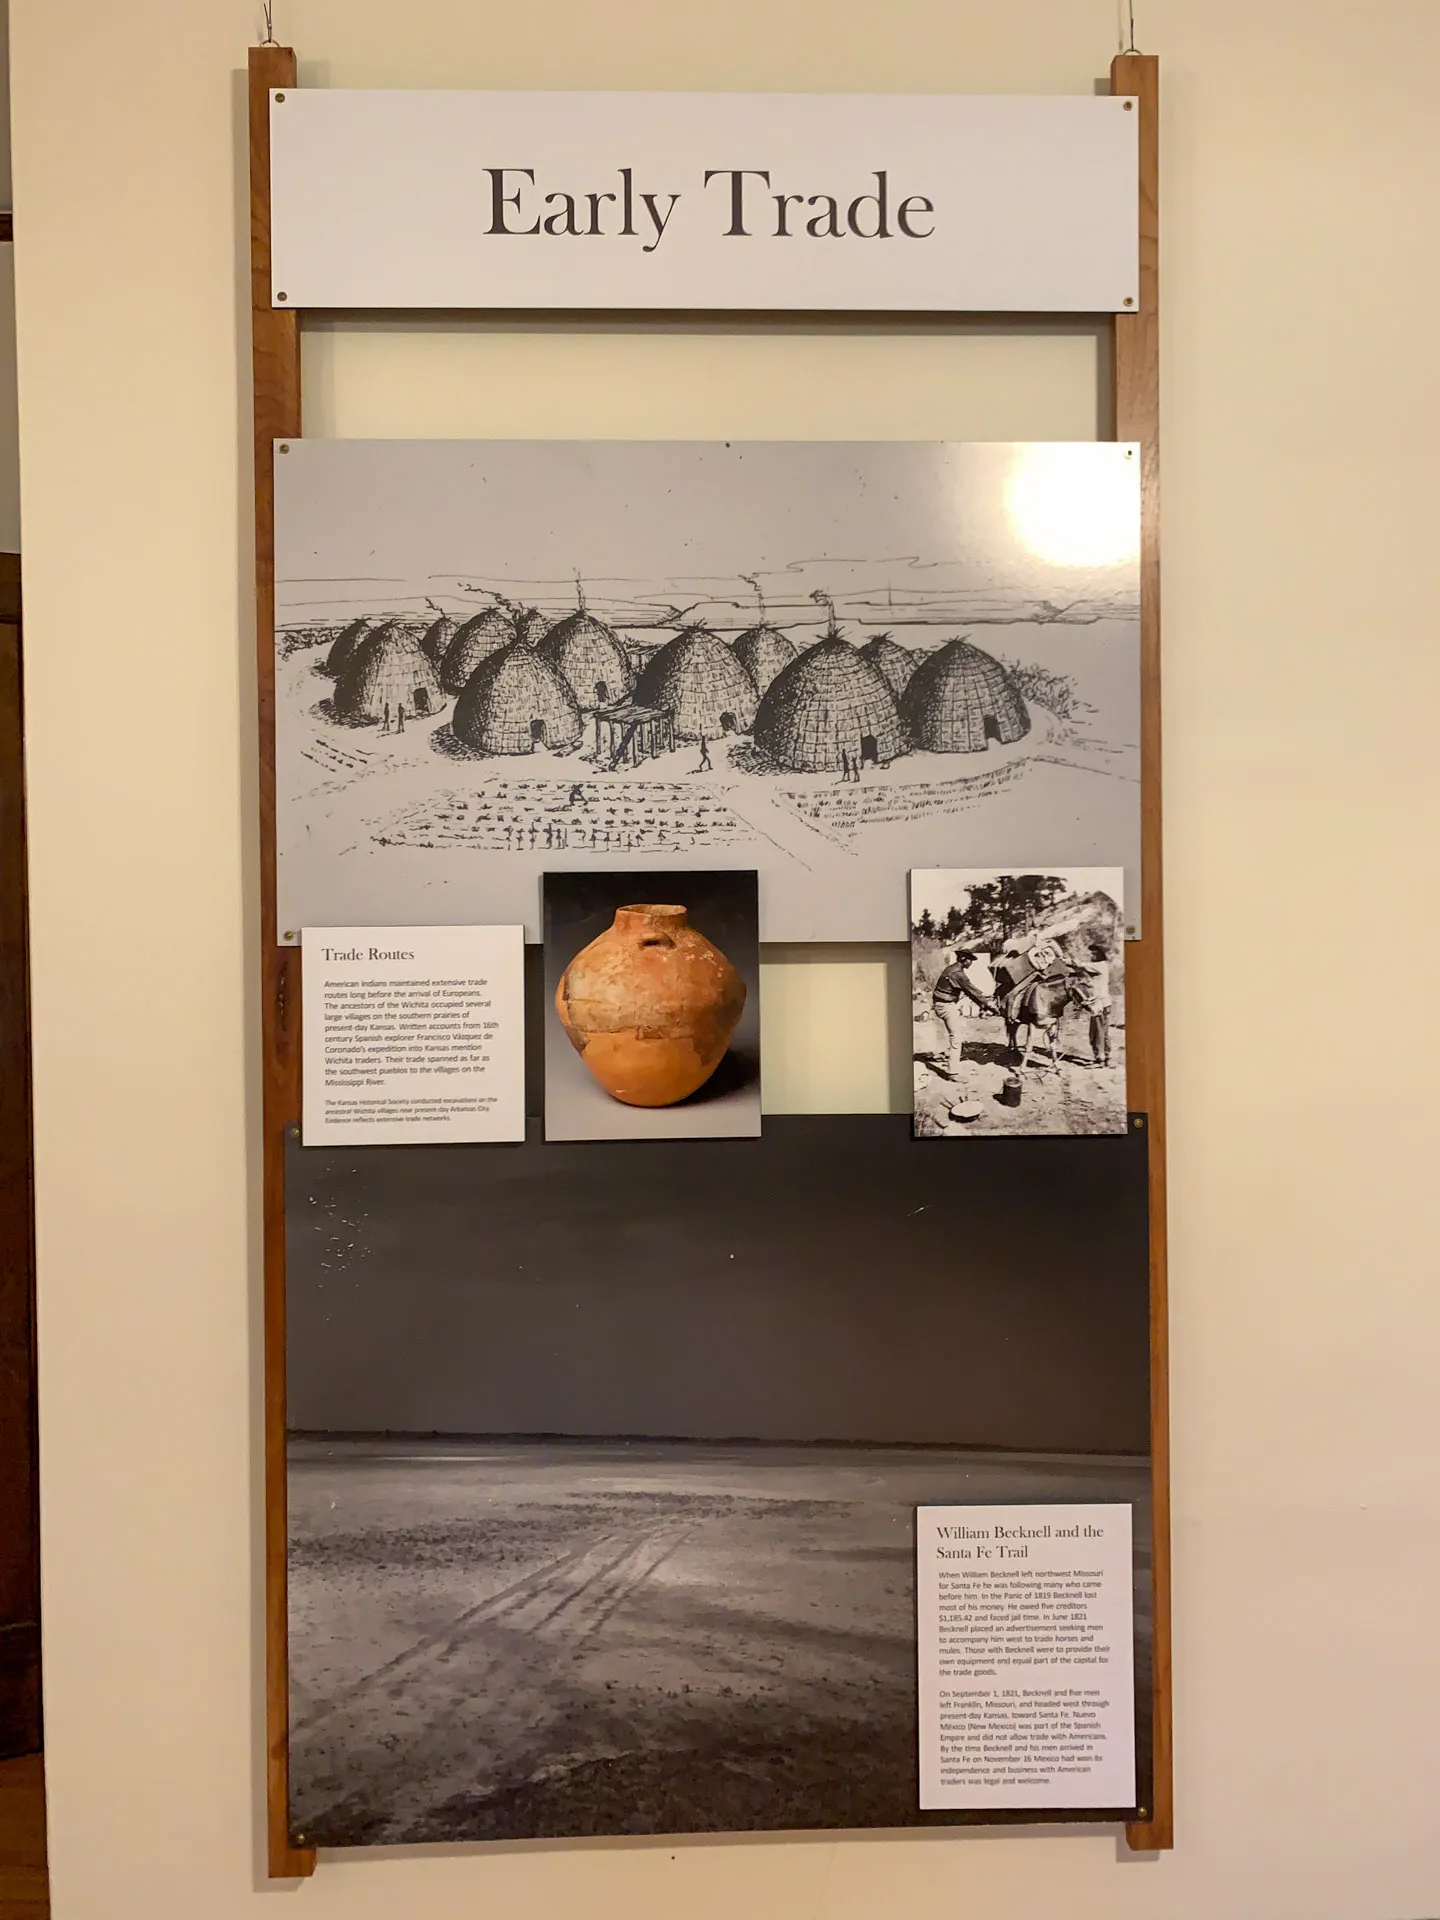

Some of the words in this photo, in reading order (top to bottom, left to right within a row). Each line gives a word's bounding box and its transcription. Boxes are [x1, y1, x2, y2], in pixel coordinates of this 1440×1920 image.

[482, 168, 681, 253] Early
[704, 170, 936, 239] Trade
[322, 948, 363, 961] Trade
[368, 947, 415, 960] Routes
[324, 979, 359, 988] American
[361, 979, 387, 988] Indians
[388, 978, 430, 987] maintained
[431, 978, 465, 987] extensive
[467, 978, 487, 986] trade
[325, 990, 348, 999] routes
[349, 990, 366, 1000] long
[367, 990, 391, 998] before
[393, 989, 406, 998] the
[407, 989, 431, 998] arrival
[432, 989, 440, 998] of
[441, 989, 481, 1000] Europeans.
[325, 1001, 338, 1010] The
[340, 1001, 375, 1010] ancestors
[377, 1001, 385, 1009] of
[386, 1000, 399, 1009] the
[401, 1000, 429, 1009] Wichita
[430, 1000, 463, 1010] occupied
[465, 999, 491, 1008] several
[325, 1012, 343, 1023] large
[344, 1012, 371, 1023] villages
[384, 1011, 396, 1020] the
[398, 1011, 431, 1020] southern
[433, 1011, 460, 1021] prairies
[461, 1010, 469, 1019] of
[398, 1021, 426, 1030] Written
[428, 1021, 460, 1030] accounts
[462, 1021, 480, 1030] from
[483, 1021, 499, 1029] 16th
[325, 1034, 353, 1045] century
[354, 1033, 382, 1044] Spanish
[384, 1033, 414, 1044] explorer
[416, 1032, 450, 1041] Francisco
[483, 1032, 493, 1040] de
[367, 1044, 406, 1055] expedition
[408, 1044, 422, 1052] into
[424, 1043, 449, 1052] Kansas
[450, 1043, 482, 1052] mention
[325, 1056, 353, 1064] Wichita
[355, 1055, 382, 1064] traders.
[385, 1055, 404, 1064] Their
[405, 1054, 425, 1063] trade
[427, 1054, 458, 1065] spanned
[469, 1054, 479, 1062] far
[325, 1067, 337, 1076] the
[339, 1066, 377, 1075] southwest
[378, 1066, 407, 1077] pueblos
[409, 1066, 417, 1074] to
[419, 1065, 432, 1074] the
[433, 1065, 459, 1076] villages
[472, 1064, 485, 1073] the
[326, 1077, 364, 1088] Mississippi
[365, 1077, 385, 1086] River.
[936, 1526, 990, 1539] William
[993, 1525, 1050, 1539] Becknell
[1055, 1525, 1079, 1538] and
[1082, 1525, 1103, 1538] the
[936, 1545, 972, 1559] Santa
[976, 1545, 991, 1558] Fe
[995, 1545, 1028, 1558] Trail
[939, 1570, 960, 1579] When
[961, 1570, 988, 1579] William
[990, 1570, 1019, 1578] Becknell
[1020, 1569, 1033, 1578] left
[1034, 1569, 1071, 1578] northwest
[1072, 1569, 1103, 1578] Missouri
[939, 1581, 949, 1590] for
[950, 1581, 970, 1590] Santa
[972, 1581, 981, 1590] Fe
[982, 1581, 992, 1590] he
[1009, 1580, 1041, 1591] following
[1043, 1583, 1063, 1591] many
[1065, 1580, 1080, 1589] who
[939, 1592, 962, 1601] before
[981, 1591, 988, 1600] In
[989, 1591, 1002, 1600] the
[1003, 1591, 1022, 1600] Panic
[1024, 1591, 1031, 1600] of
[1034, 1591, 1051, 1599] 1819
[1052, 1590, 1082, 1599] Becknell
[939, 1603, 956, 1611] most
[958, 1602, 966, 1611] of
[967, 1602, 978, 1611] his
[1007, 1602, 1017, 1611] He
[1019, 1602, 1039, 1610] owed
[1041, 1602, 1054, 1610] five
[1055, 1601, 1087, 1610] creditors
[974, 1613, 988, 1622] and
[989, 1613, 1009, 1622] faced
[1010, 1613, 1021, 1623] jail
[1022, 1613, 1040, 1621] time.
[1042, 1613, 1050, 1621] In
[1052, 1613, 1067, 1621] June
[1070, 1612, 1086, 1621] 1821
[939, 1624, 968, 1633] Becknell
[970, 1624, 993, 1634] placed
[1005, 1623, 1056, 1632] advertisement
[1058, 1623, 1085, 1634] seeking
[939, 1635, 947, 1644] to
[948, 1637, 988, 1646] accompany
[990, 1635, 1004, 1643] him
[1006, 1634, 1022, 1643] west
[1024, 1634, 1032, 1643] to
[1034, 1634, 1053, 1643] trade
[1054, 1634, 1078, 1643] horses
[1080, 1634, 1093, 1642] and
[965, 1646, 985, 1654] Those
[987, 1646, 1003, 1654] with
[1005, 1645, 1034, 1654] Becknell
[1055, 1645, 1063, 1653] to
[1065, 1645, 1092, 1655] provide
[1094, 1644, 1110, 1653] their
[956, 1657, 994, 1667] equipment
[996, 1656, 1010, 1665] and
[1012, 1656, 1031, 1667] equal
[1033, 1656, 1048, 1667] part
[1050, 1656, 1057, 1665] of
[1059, 1656, 1071, 1664] the
[1073, 1656, 1096, 1666] capital
[1098, 1655, 1108, 1664] for
[939, 1668, 951, 1676] the
[953, 1668, 972, 1676] trade
[973, 1667, 997, 1678] goods.
[940, 1689, 950, 1698] On
[951, 1689, 990, 1700] September
[1022, 1689, 1051, 1697] Becknell
[1053, 1688, 1067, 1697] and
[1068, 1688, 1081, 1697] five
